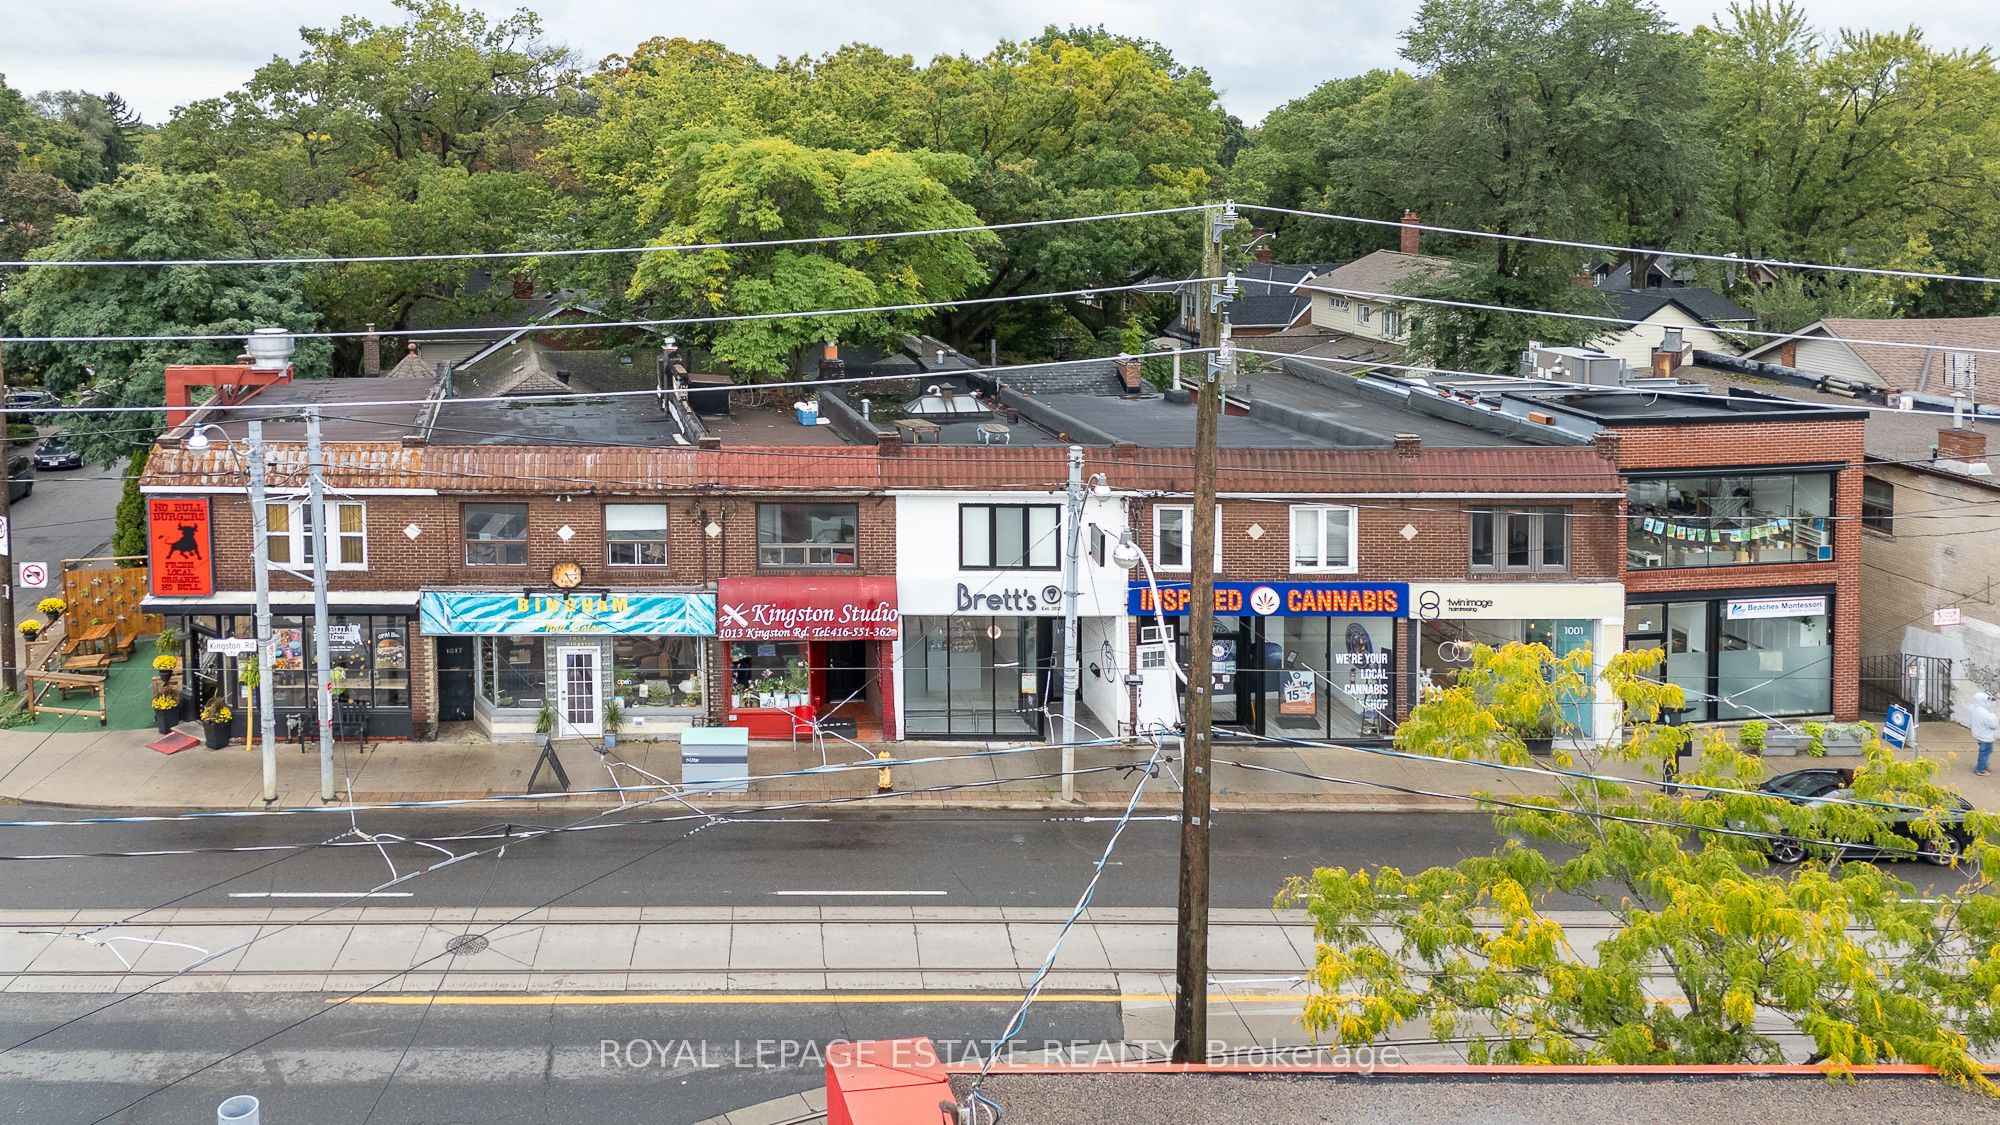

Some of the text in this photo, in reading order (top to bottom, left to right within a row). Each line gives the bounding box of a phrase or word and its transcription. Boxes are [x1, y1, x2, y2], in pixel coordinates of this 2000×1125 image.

[154, 503, 203, 512] NO BULL
[153, 512, 204, 521] BURGERS
[957, 583, 1037, 611] Brett's
[1140, 588, 1399, 612] INSPED CANNABIS
[517, 598, 629, 613] BINGHAM
[1747, 603, 1779, 611] Beaches
[752, 602, 899, 628] Kingston Studio
[719, 628, 743, 639] 1013
[745, 627, 791, 640] Kingston
[793, 627, 810, 640] Rd.
[1564, 626, 1584, 635] 1001
[209, 641, 255, 651] Kingston Rd
[446, 647, 463, 655] 1017
[1335, 653, 1388, 665] WE'RE YOUR
[1360, 668, 1388, 680] LOCAL
[1286, 689, 1300, 701] 15
[1344, 684, 1389, 695] CANNABIS
